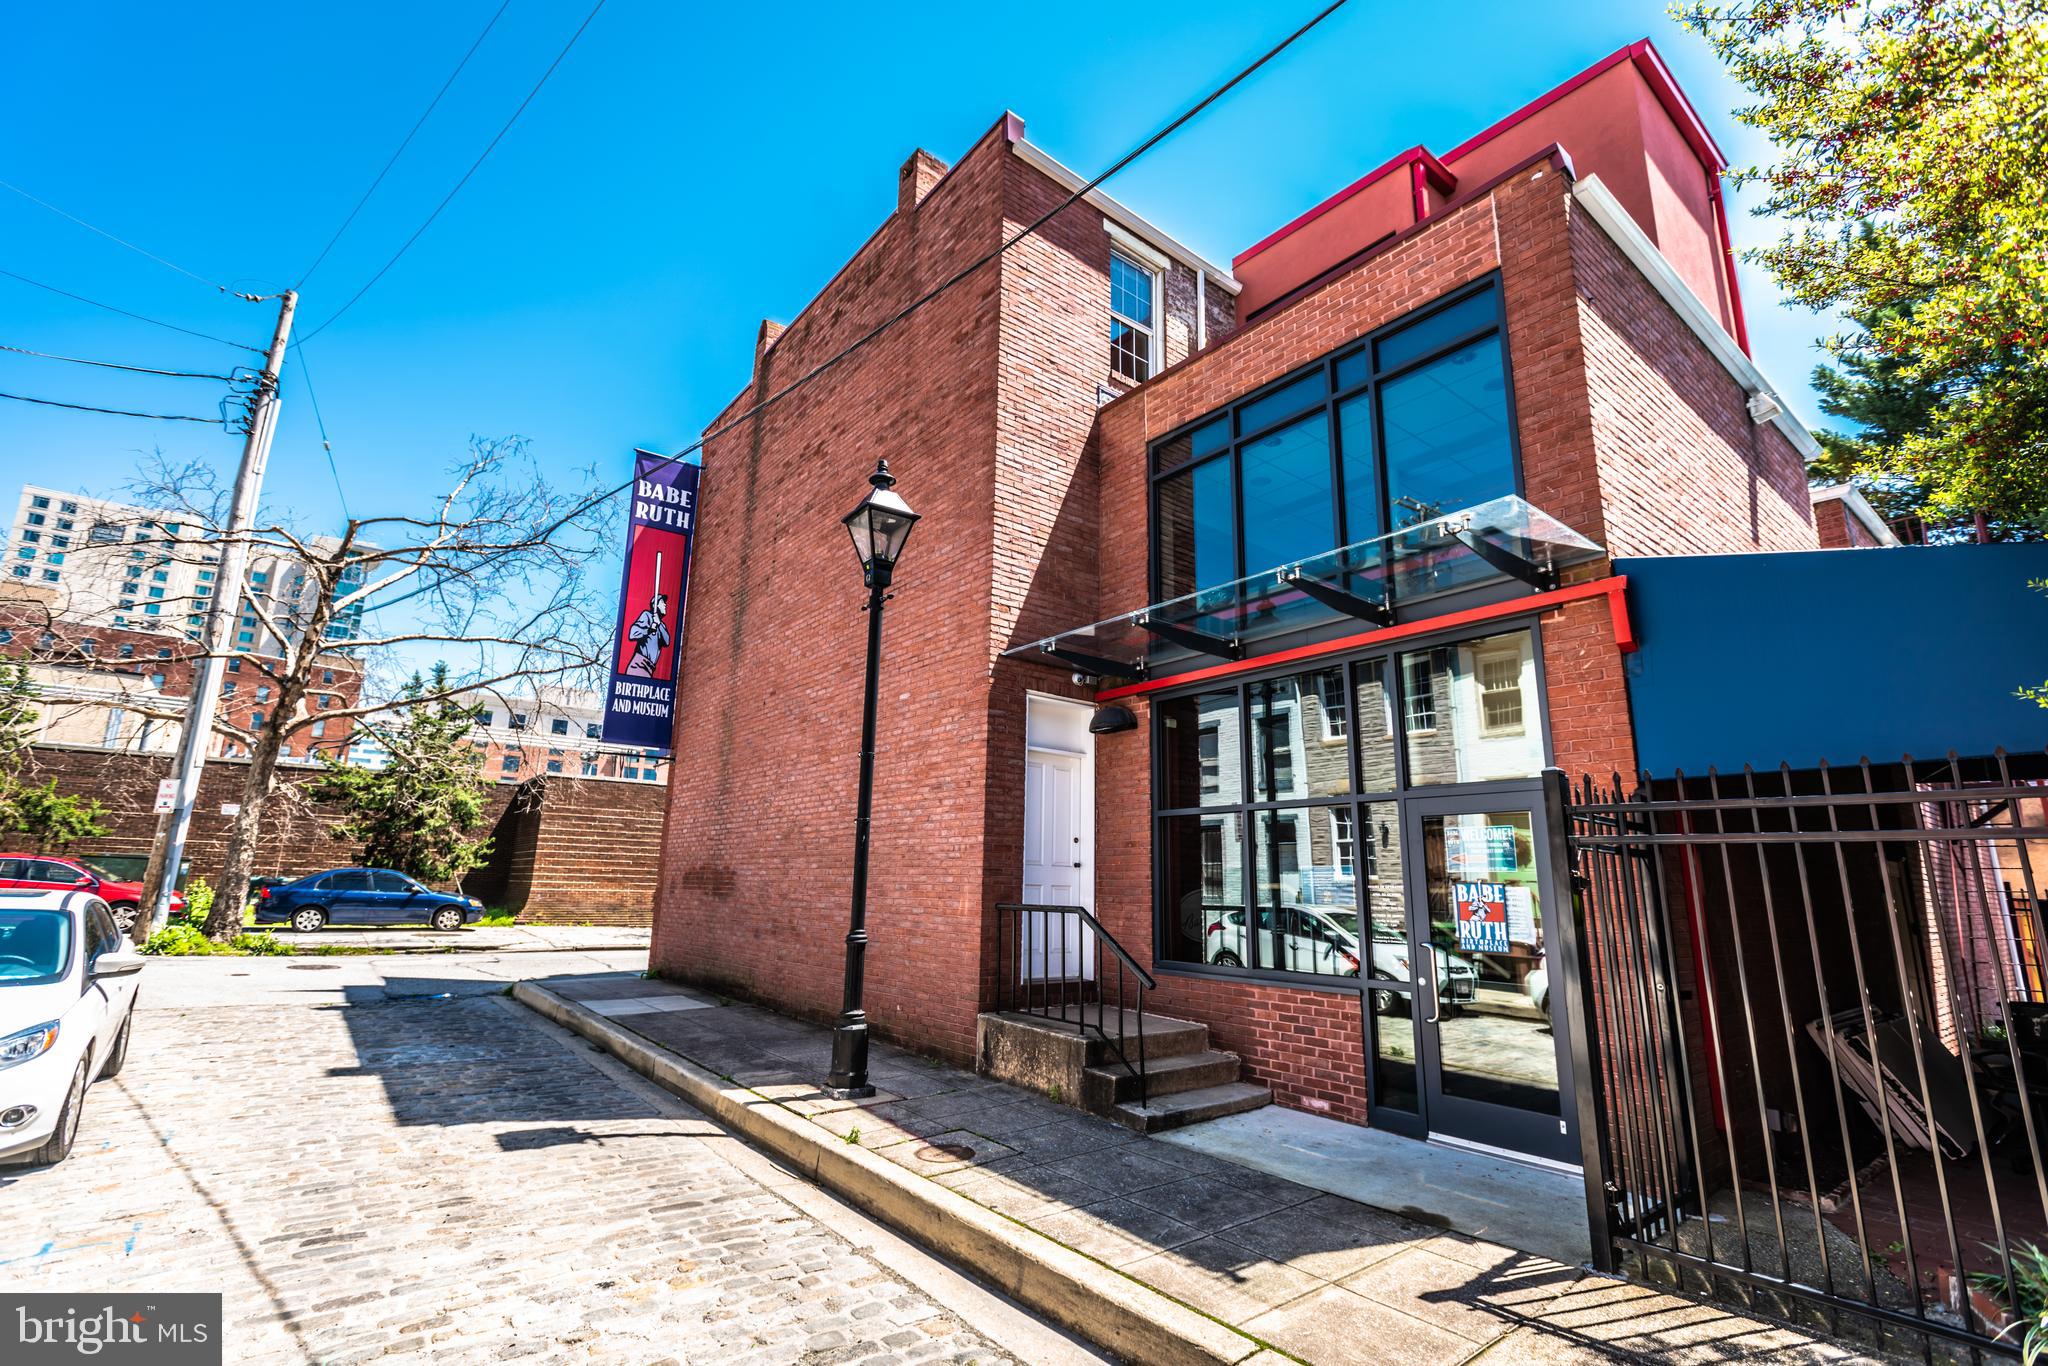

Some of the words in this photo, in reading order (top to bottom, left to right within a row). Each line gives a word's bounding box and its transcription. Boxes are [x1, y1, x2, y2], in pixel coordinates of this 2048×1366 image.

[637, 479, 692, 508] BABE
[635, 500, 690, 529] RUTH
[614, 681, 671, 702] BIRTHPLACE
[611, 700, 631, 714] AND
[632, 703, 669, 718] MUSEUM
[1462, 827, 1512, 841] WELCOME!
[1456, 884, 1504, 903] BABE
[1460, 920, 1508, 941] RUTH
